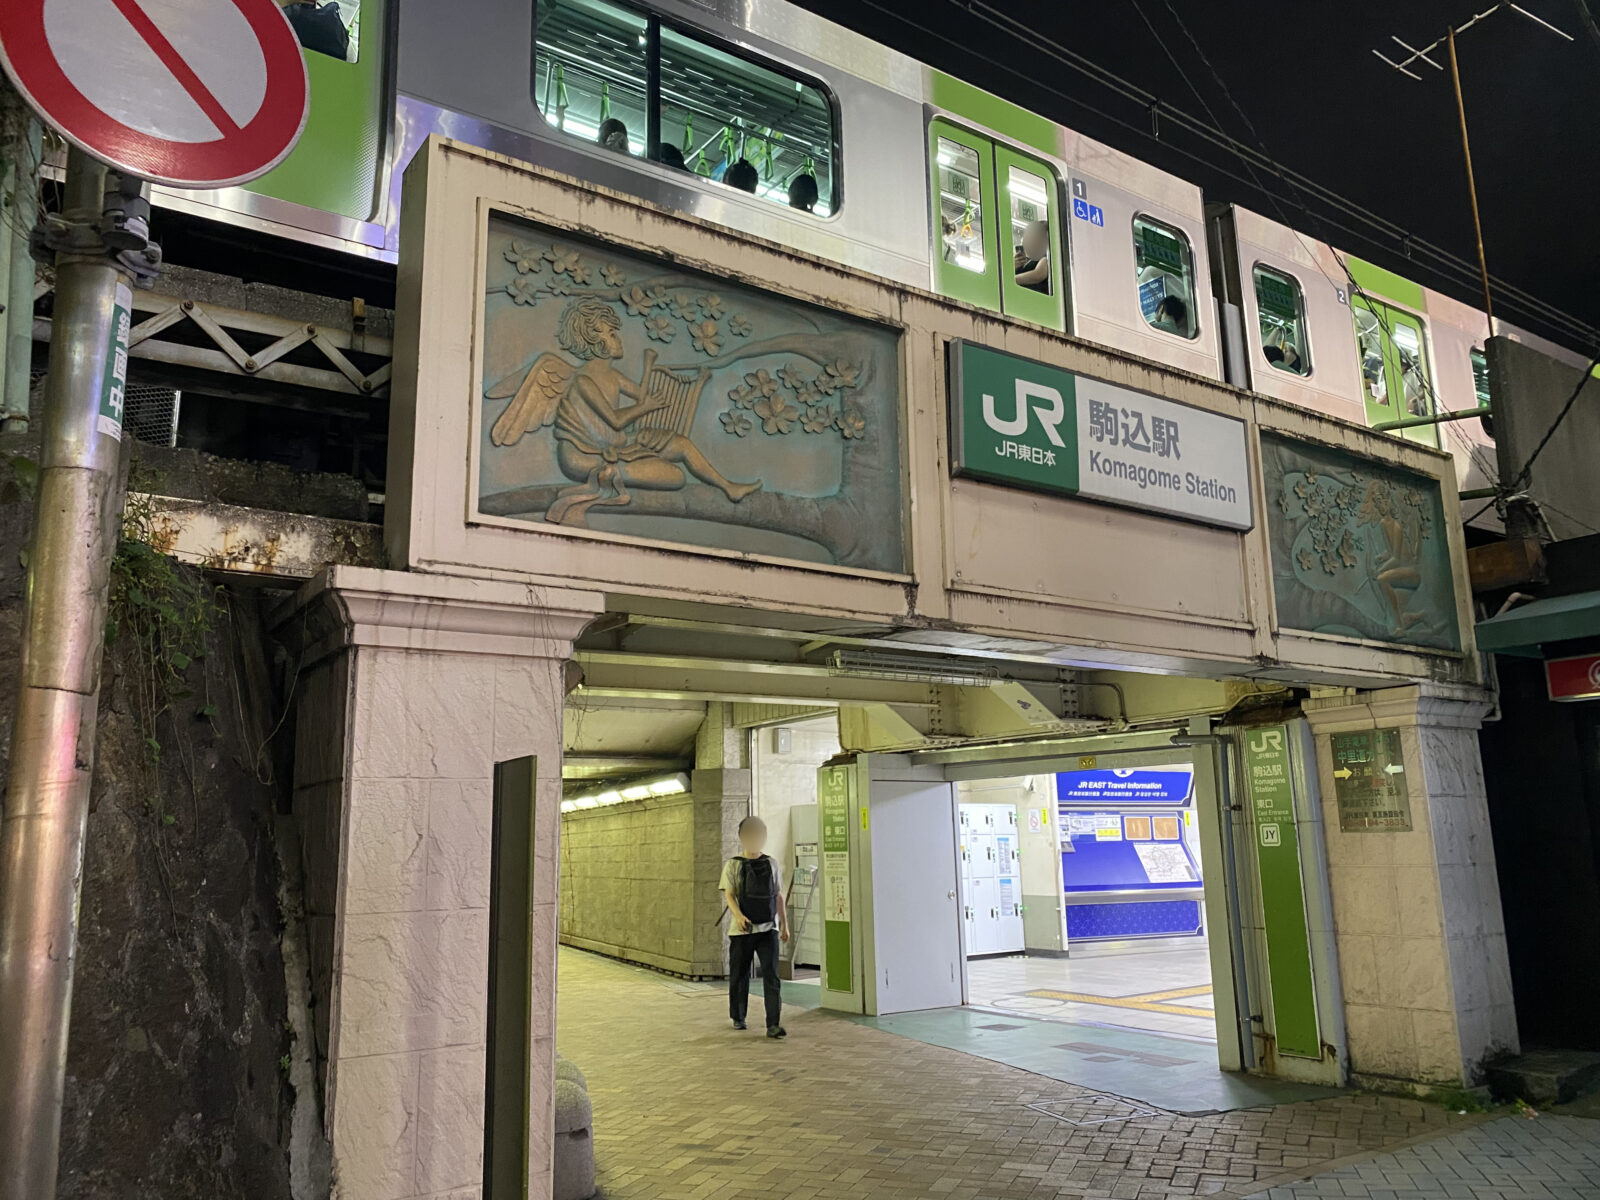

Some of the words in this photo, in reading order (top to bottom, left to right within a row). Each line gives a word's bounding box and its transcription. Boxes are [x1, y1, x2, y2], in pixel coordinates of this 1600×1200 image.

[1077, 182, 1083, 196] 1
[1338, 290, 1345, 303] 2
[982, 378, 1066, 448] JR
[1088, 399, 1181, 461] 駒込駅
[995, 440, 1056, 467] JR東日本
[1089, 450, 1181, 490] Komagome
[1185, 472, 1236, 504] Station
[1251, 730, 1282, 753] JR
[1253, 764, 1283, 777] 駒込駅
[828, 771, 844, 786] JR
[1078, 781, 1087, 789] JR
[1088, 781, 1106, 789] EAST
[1254, 778, 1286, 786] Komagome
[1257, 799, 1273, 809] 東口
[1265, 830, 1275, 840] JY
